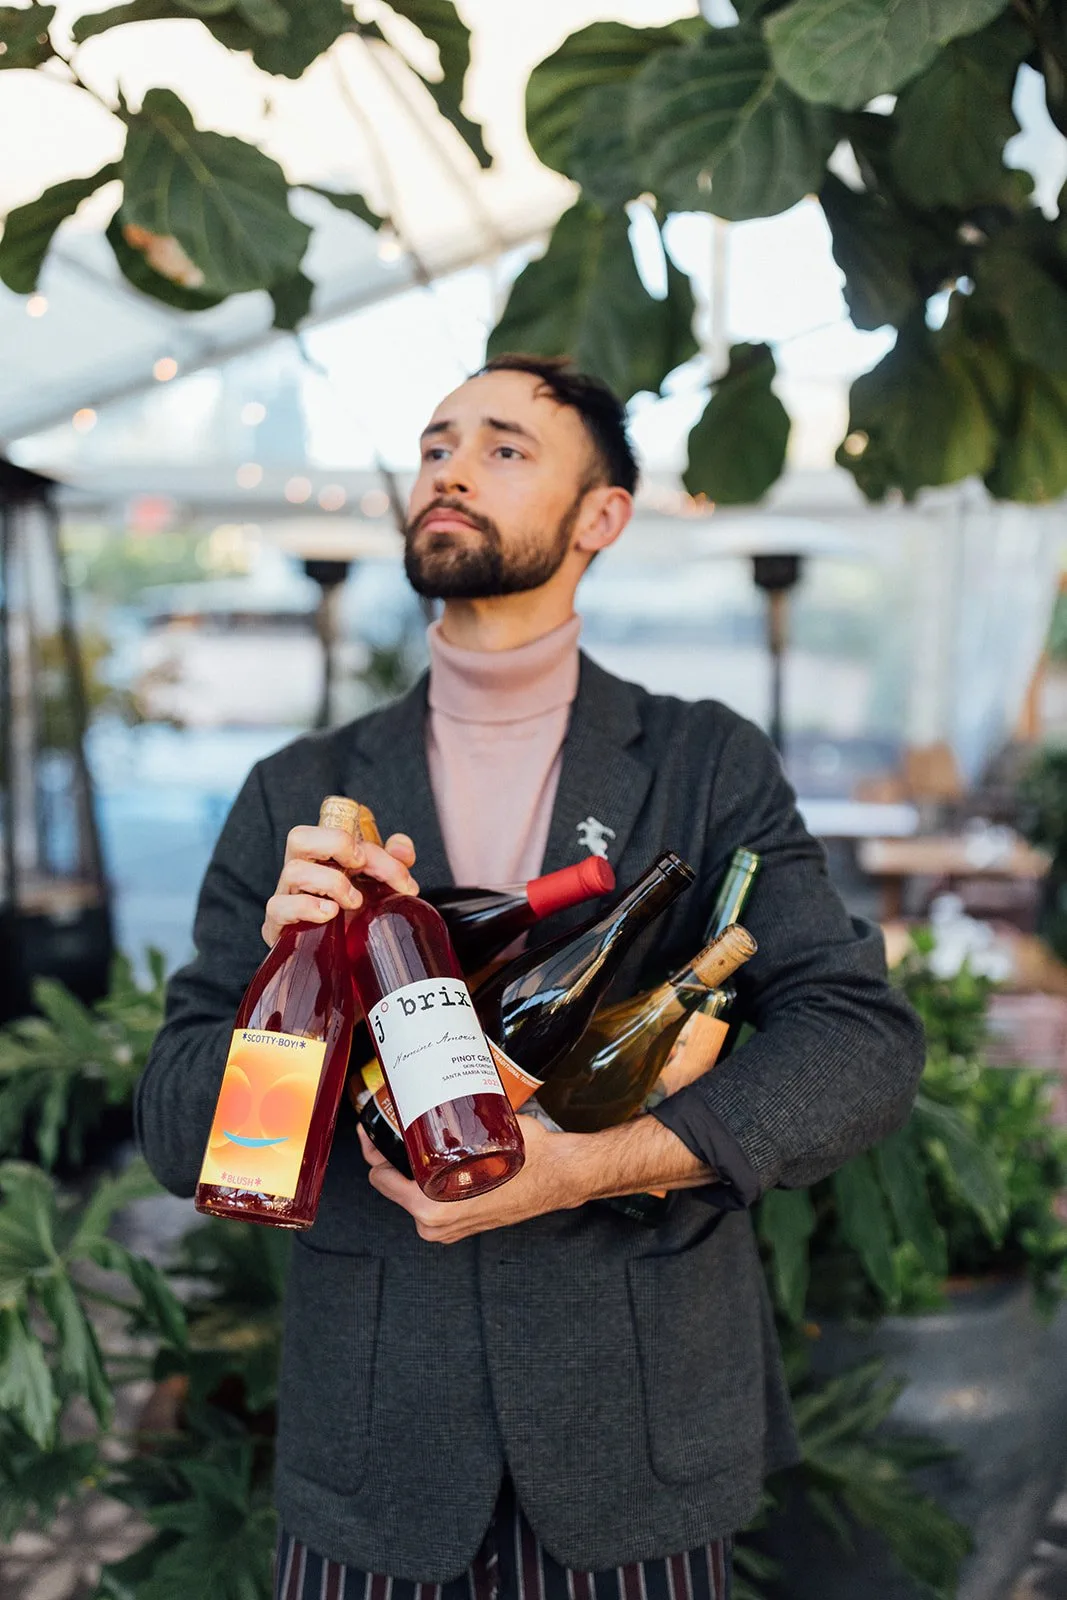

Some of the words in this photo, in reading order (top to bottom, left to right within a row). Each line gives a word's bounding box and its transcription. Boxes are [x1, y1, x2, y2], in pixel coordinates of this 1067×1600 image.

[397, 986, 472, 1017] brix
[392, 1040, 434, 1069] Nomine
[451, 1054, 476, 1064] PINOT
[441, 1070, 463, 1082] SANTA
